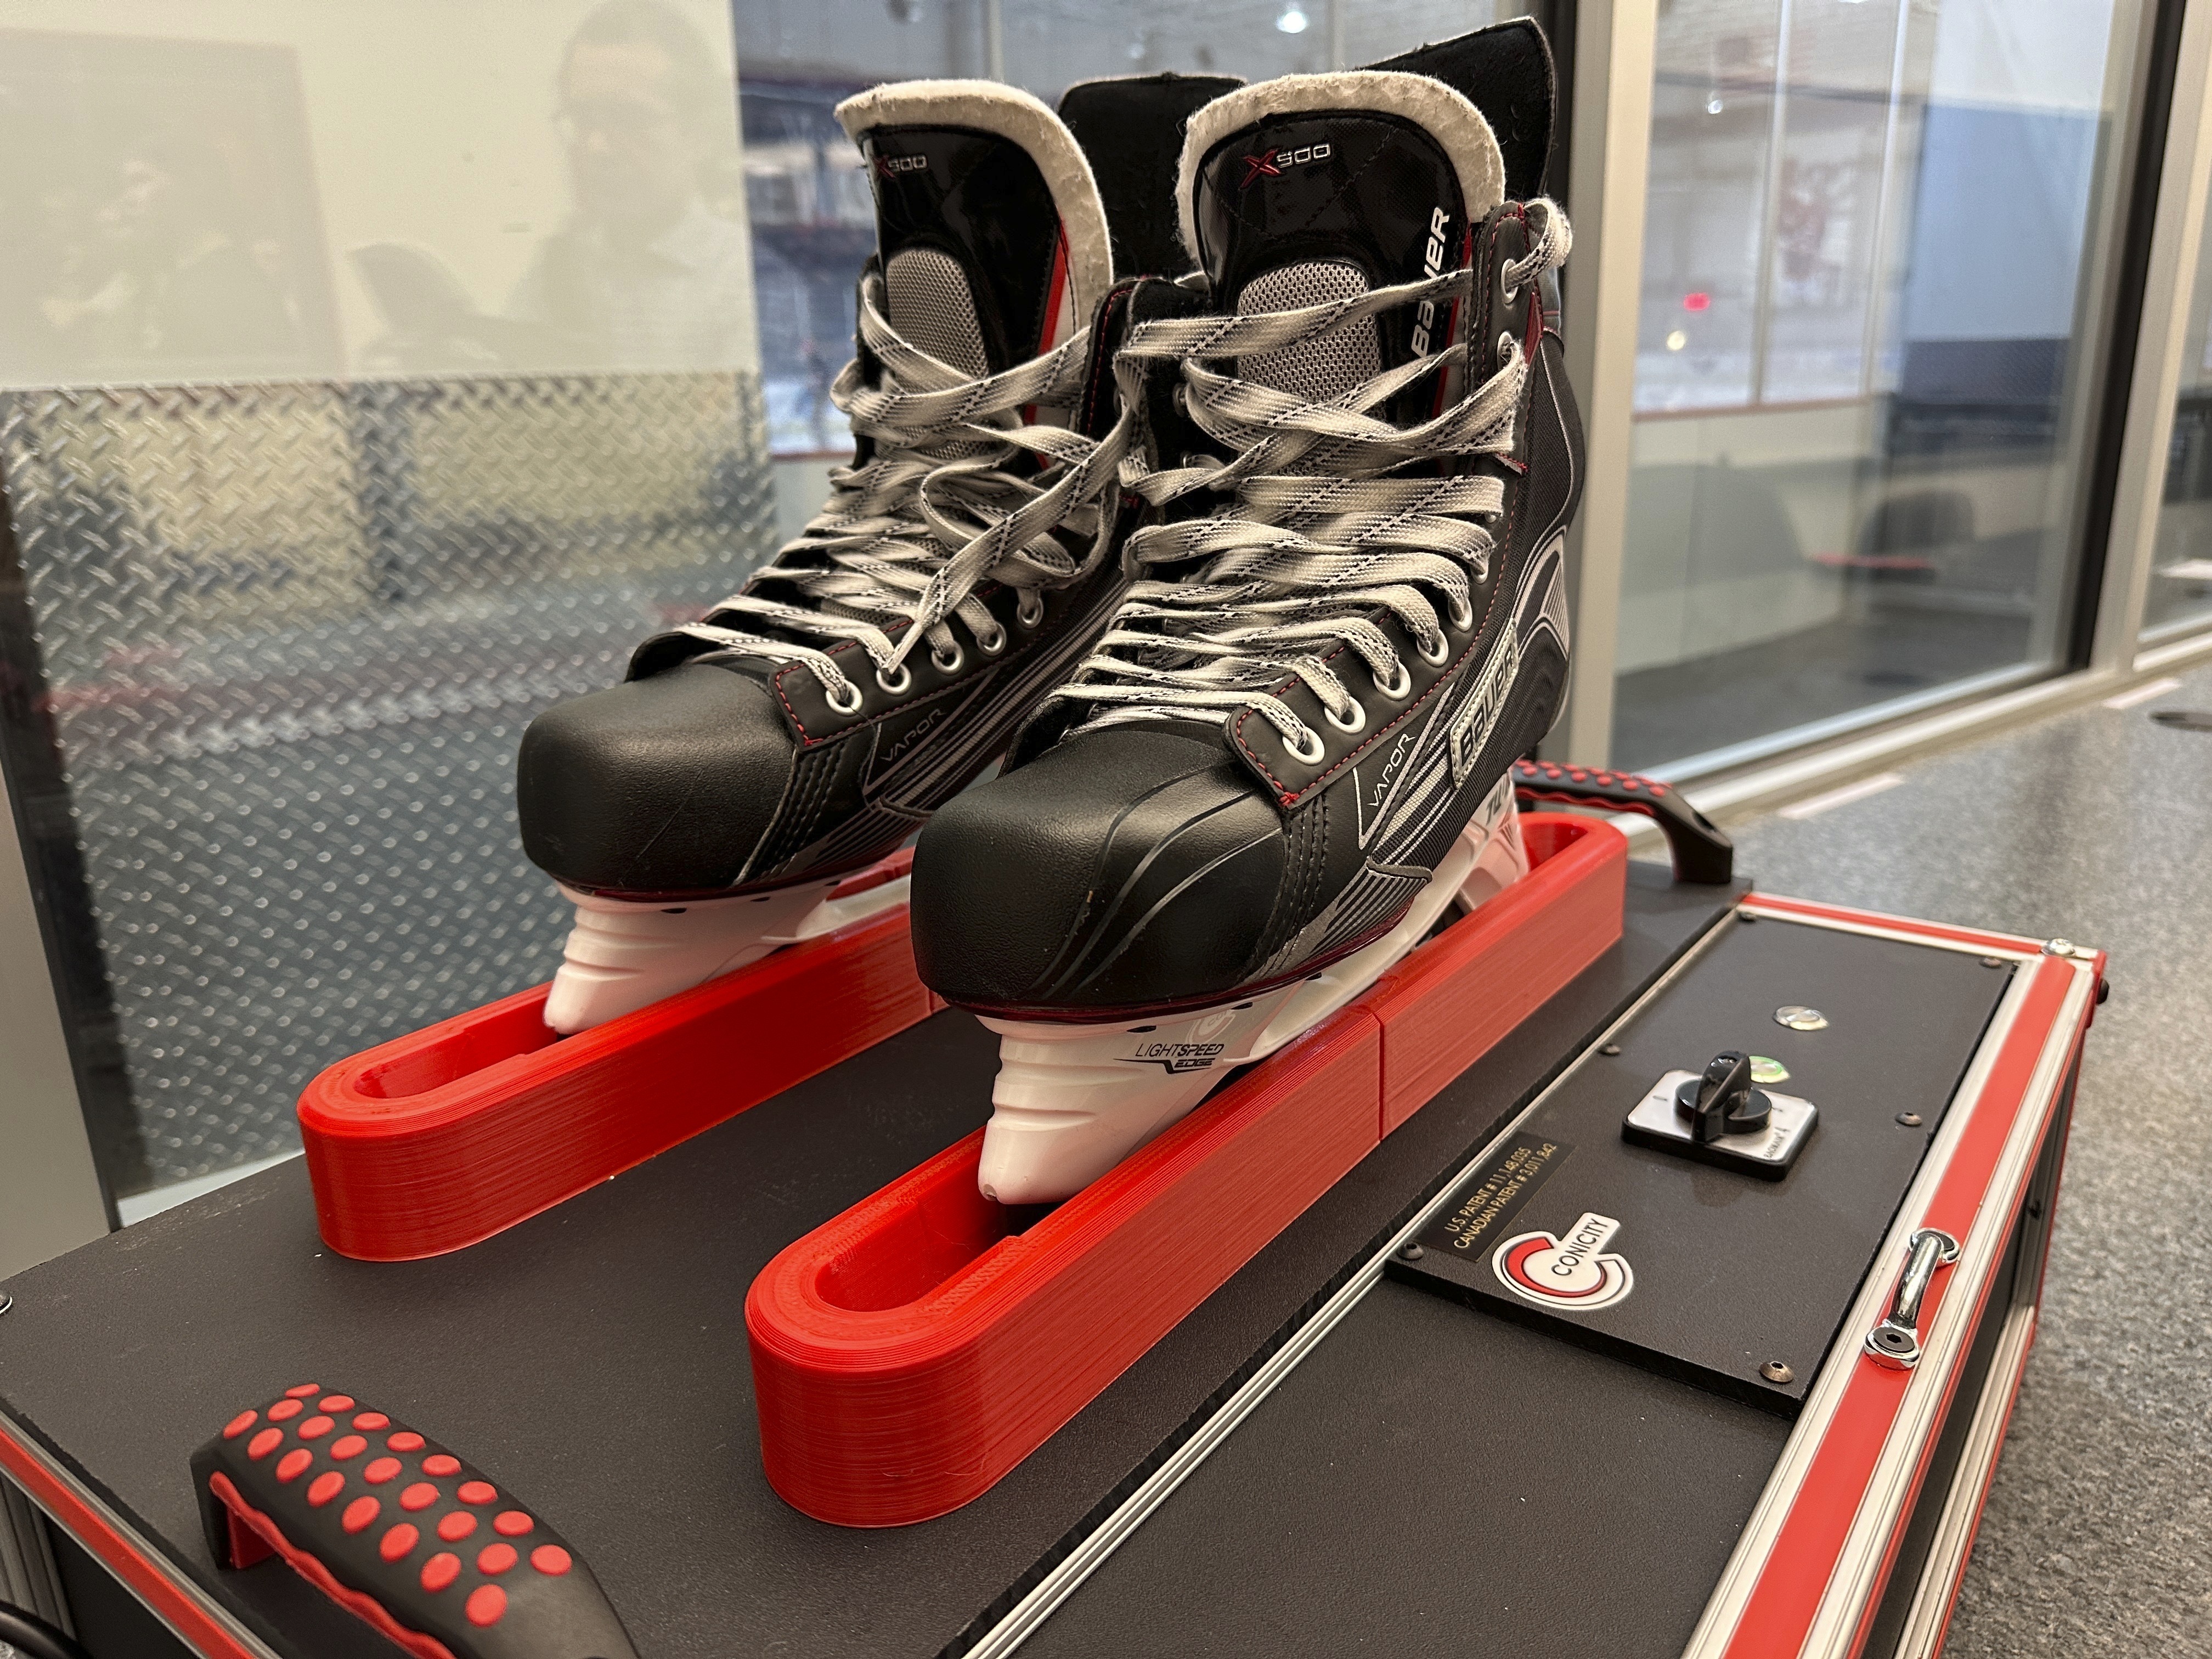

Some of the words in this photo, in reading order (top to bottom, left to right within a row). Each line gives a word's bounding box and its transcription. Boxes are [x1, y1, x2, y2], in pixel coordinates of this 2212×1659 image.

[879, 708, 945, 761] VAPOR
[1367, 733, 1417, 806] VAPOR
[1135, 1043, 1225, 1057] LIGHTSPEED
[1174, 1058, 1216, 1068] EDGE
[1444, 1217, 1469, 1232] U.S.
[1458, 1188, 1493, 1217] PATENT
[1485, 1182, 1498, 1191] #
[1453, 1205, 1500, 1249] CANADIAN
[1489, 1180, 1523, 1207] PATENT
[1515, 1174, 1528, 1182] #
[1551, 1217, 1609, 1276] CONICITY
